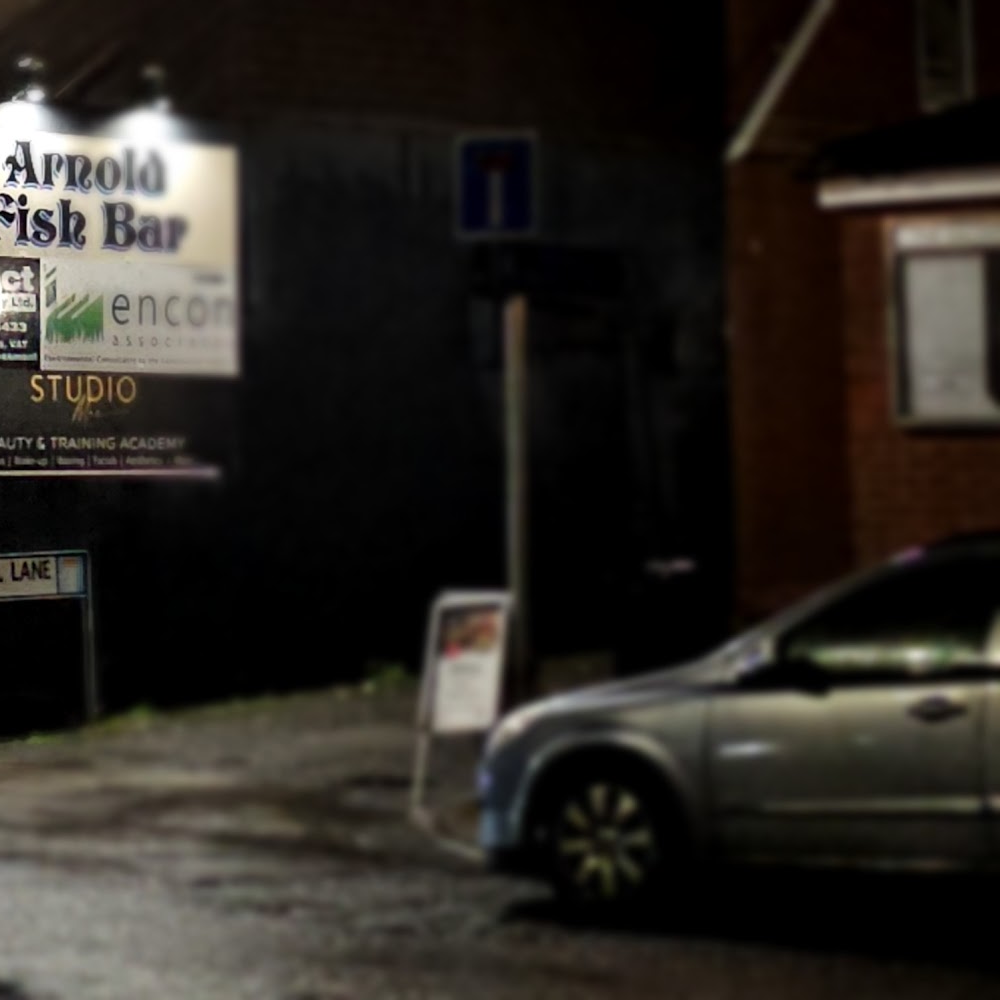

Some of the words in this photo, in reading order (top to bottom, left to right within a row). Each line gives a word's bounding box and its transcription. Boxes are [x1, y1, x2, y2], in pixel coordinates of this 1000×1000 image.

[3, 140, 167, 194] Arnold
[101, 201, 188, 254] Bar
[30, 374, 137, 403] STUDIO
[50, 436, 116, 450] TRAINING
[119, 436, 186, 451] ACADEMY
[11, 559, 51, 582] LANE
